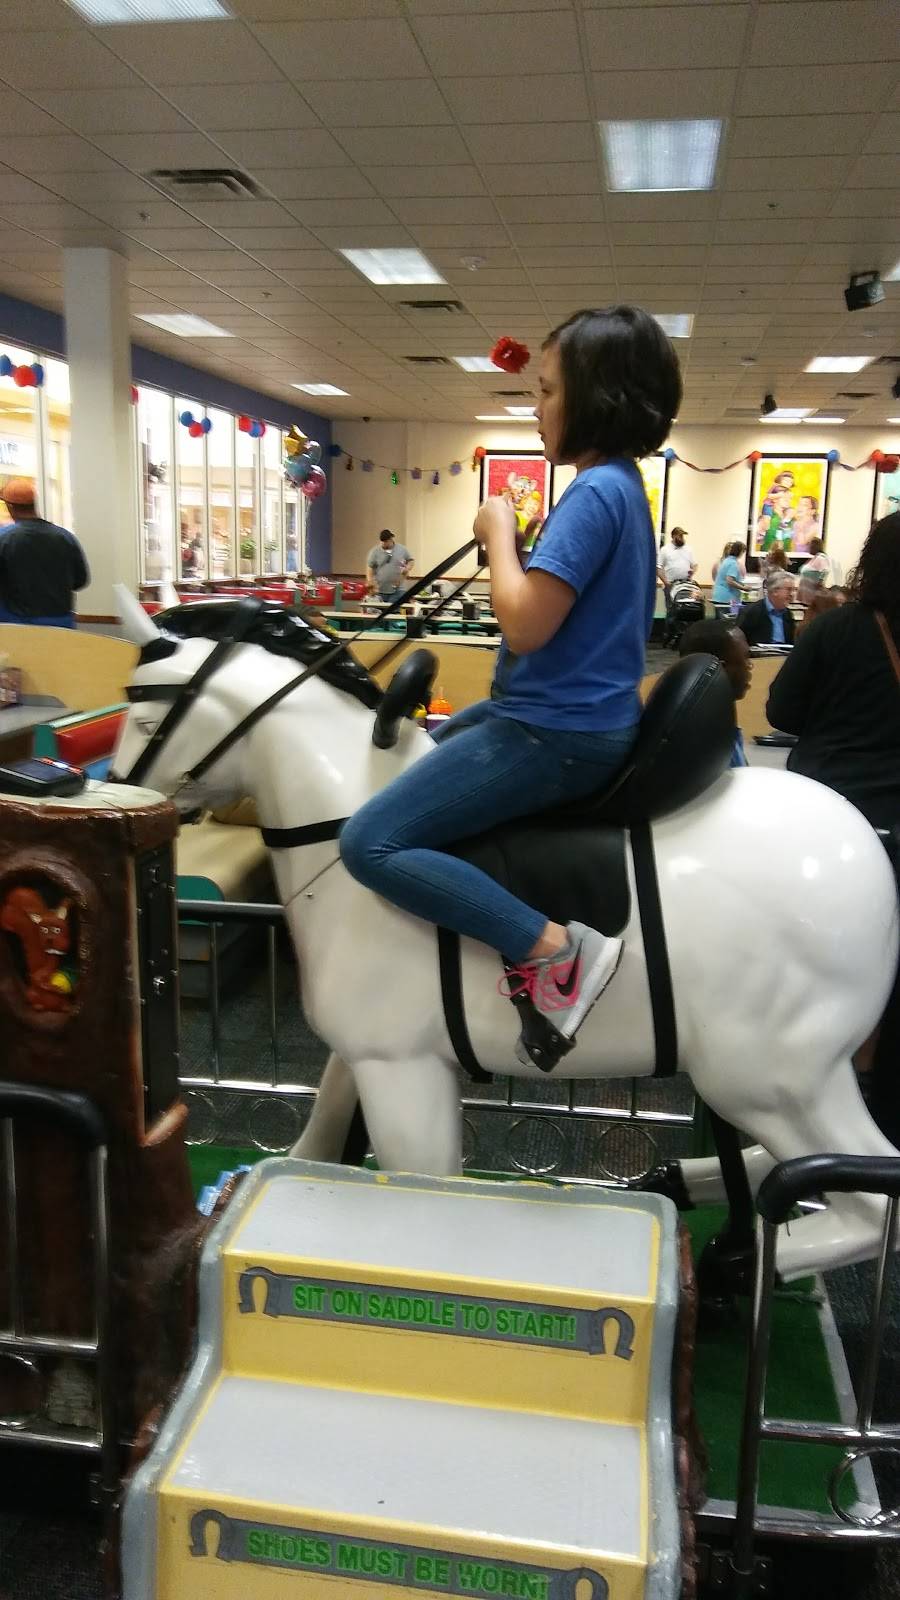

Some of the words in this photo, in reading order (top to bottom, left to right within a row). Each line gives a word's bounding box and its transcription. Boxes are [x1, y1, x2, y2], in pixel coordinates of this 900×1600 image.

[293, 1285, 326, 1310] SIT
[333, 1290, 362, 1316] ON
[368, 1293, 455, 1328] SADDLE
[460, 1304, 490, 1332] TO
[495, 1308, 577, 1342] START!
[247, 1529, 329, 1566] SHOES
[337, 1545, 408, 1577] MUST
[414, 1556, 450, 1585] BE
[457, 1562, 549, 1599] WORN!
